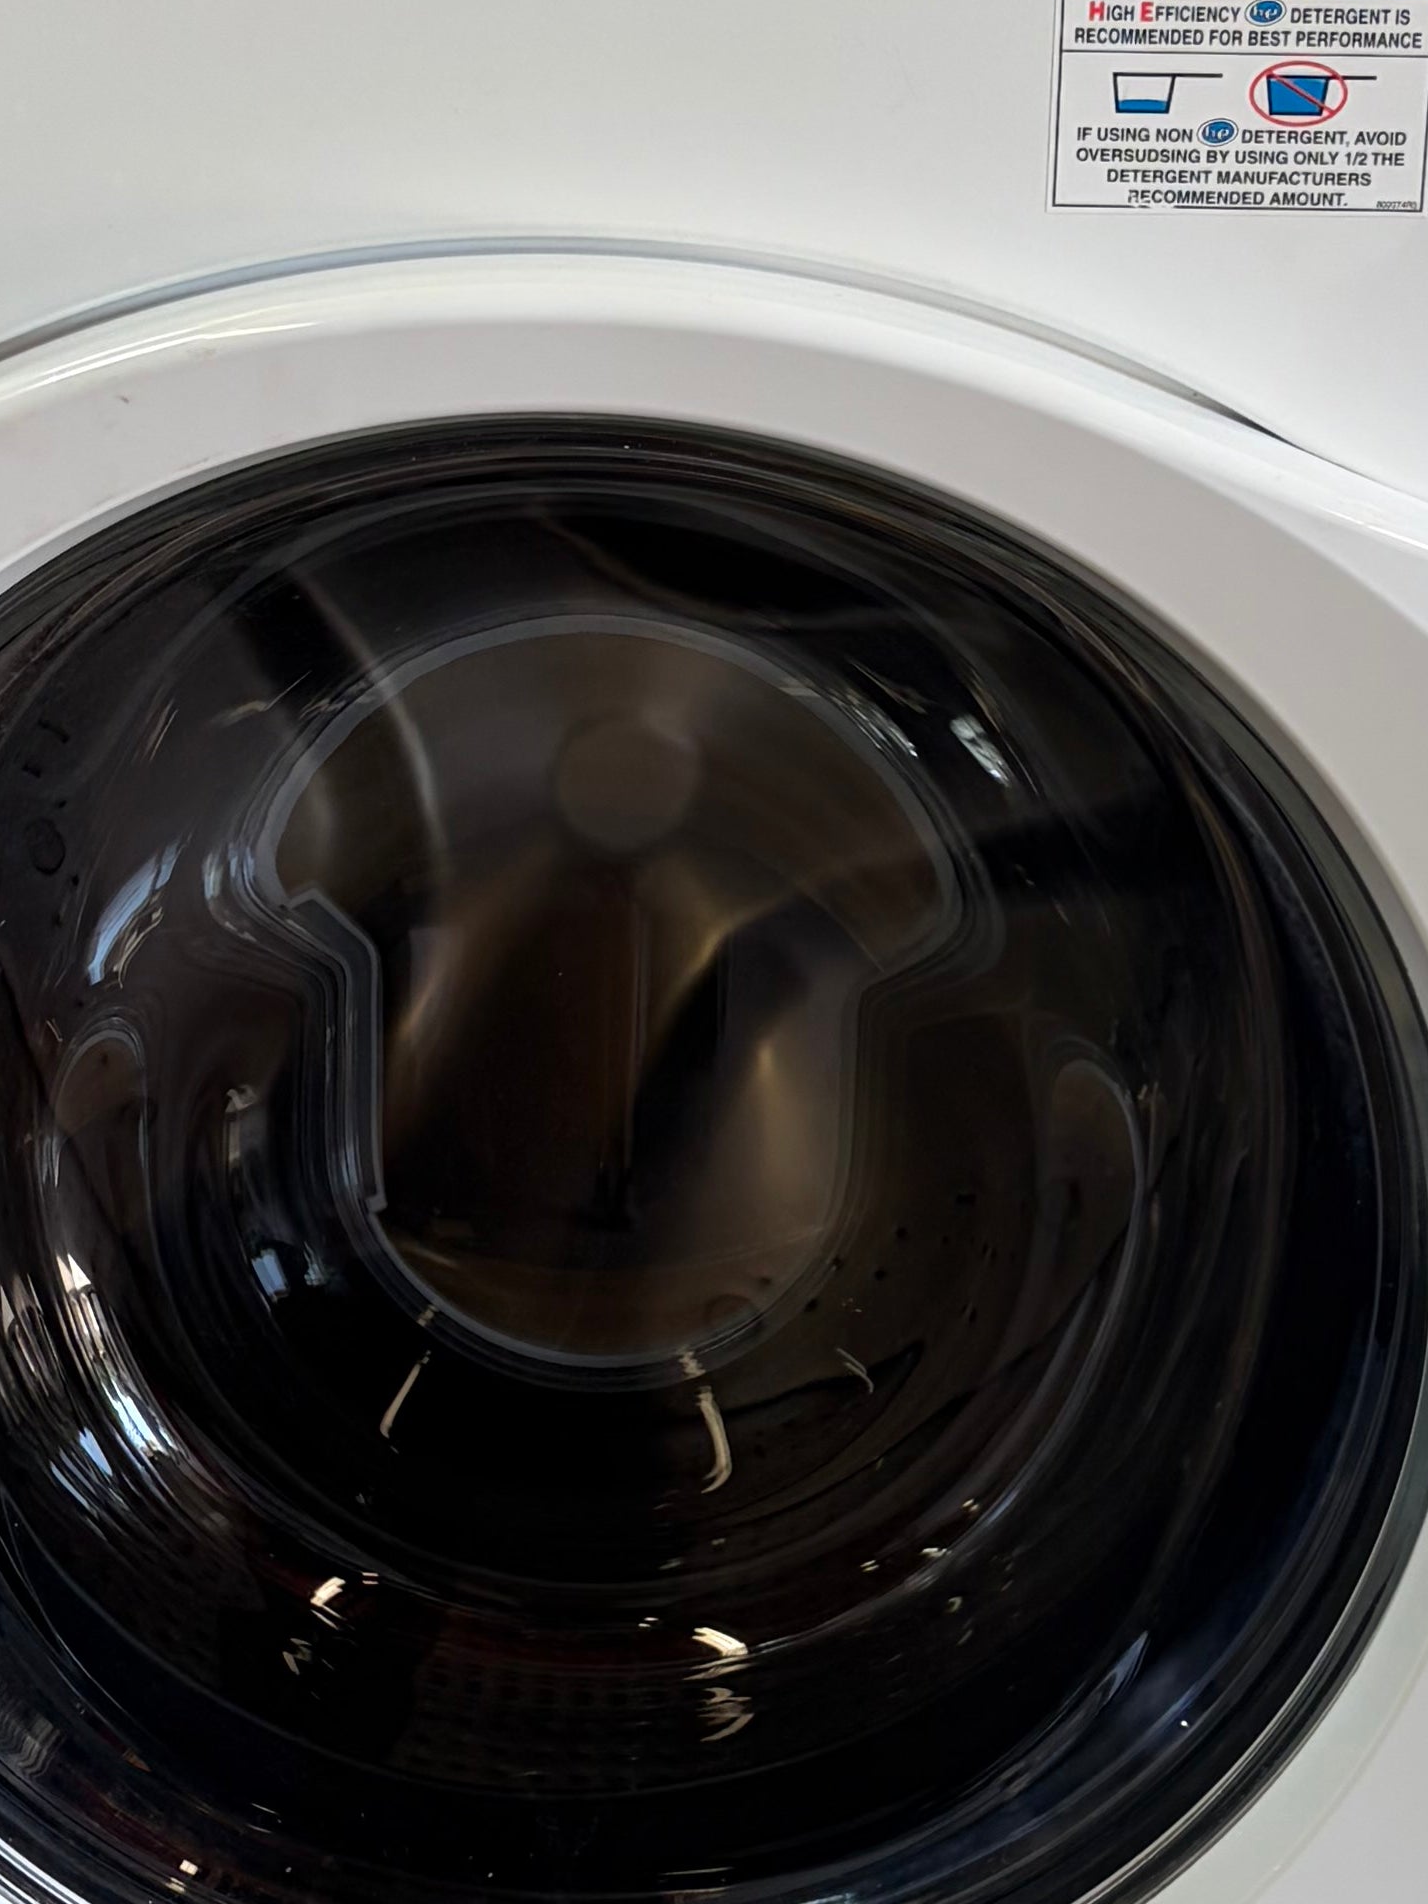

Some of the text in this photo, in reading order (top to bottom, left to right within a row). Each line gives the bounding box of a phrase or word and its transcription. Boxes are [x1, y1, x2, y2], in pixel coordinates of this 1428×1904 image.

[1088, 1, 1135, 23] HIGH
[1140, 1, 1241, 24] EFFICIENCY
[1290, 7, 1392, 25] DETERGENT
[1395, 8, 1411, 26] IS
[1075, 29, 1423, 49] RECOMMENDED FOR BEST PERFORMANCE
[1076, 126, 1093, 141] IF
[1096, 126, 1151, 143] USING
[1155, 127, 1194, 143] NON
[1241, 128, 1350, 147] DETERGENT,
[1354, 130, 1407, 146] AVOID
[1075, 147, 1405, 167] OVERSUDSING BY USING ONLY 1/2 THE
[1106, 168, 1372, 187] DETERGENT MANUFACTURERS
[1128, 189, 1348, 207] RECOMMENDED AMOUNT.
